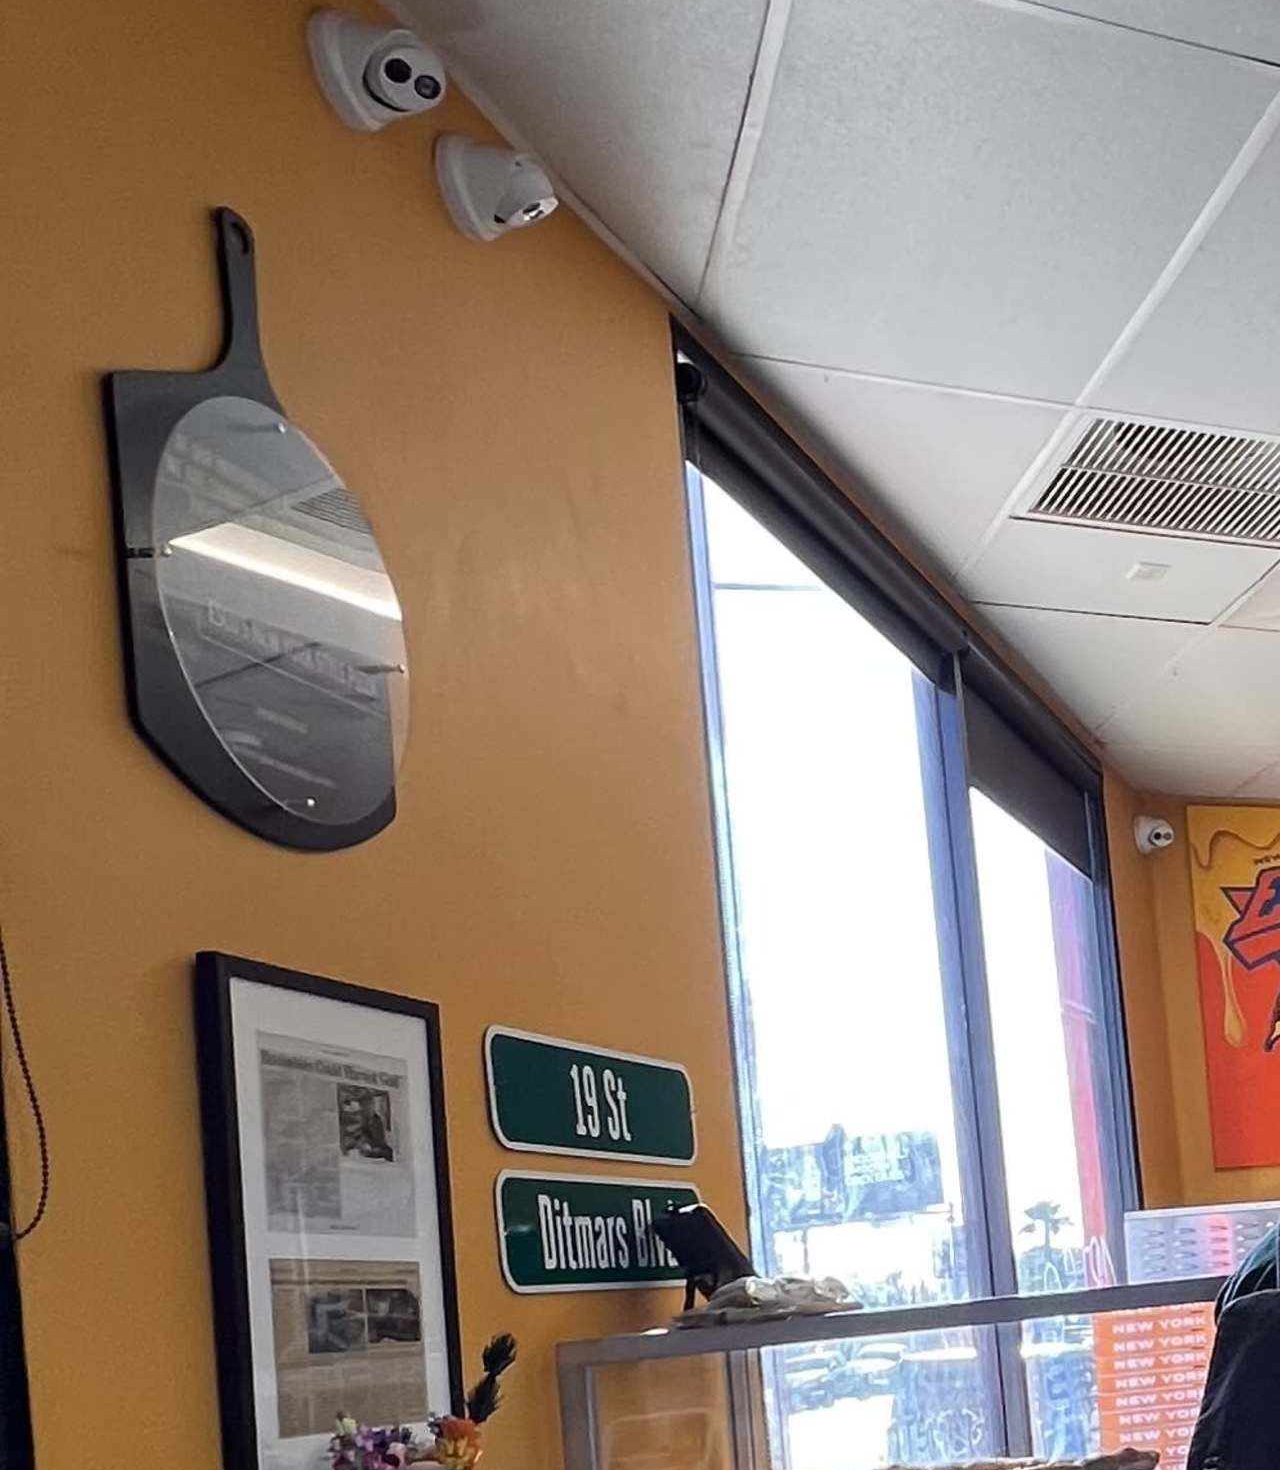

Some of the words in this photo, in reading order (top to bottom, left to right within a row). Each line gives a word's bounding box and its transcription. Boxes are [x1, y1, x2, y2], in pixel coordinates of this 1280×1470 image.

[569, 1063, 601, 1138] 19
[602, 1068, 632, 1141] St
[537, 1193, 630, 1271] Ditmars
[1113, 1321, 1154, 1334] NEW
[1160, 1316, 1206, 1330] YORK
[1113, 1339, 1155, 1353] NEW
[1160, 1334, 1207, 1348] YORK
[1113, 1357, 1156, 1370] NEW
[1160, 1352, 1207, 1364] YORK
[1115, 1376, 1156, 1389] NEW
[1115, 1394, 1157, 1407] NEW
[1119, 1412, 1160, 1425] NEW
[1119, 1431, 1160, 1444] NEW
